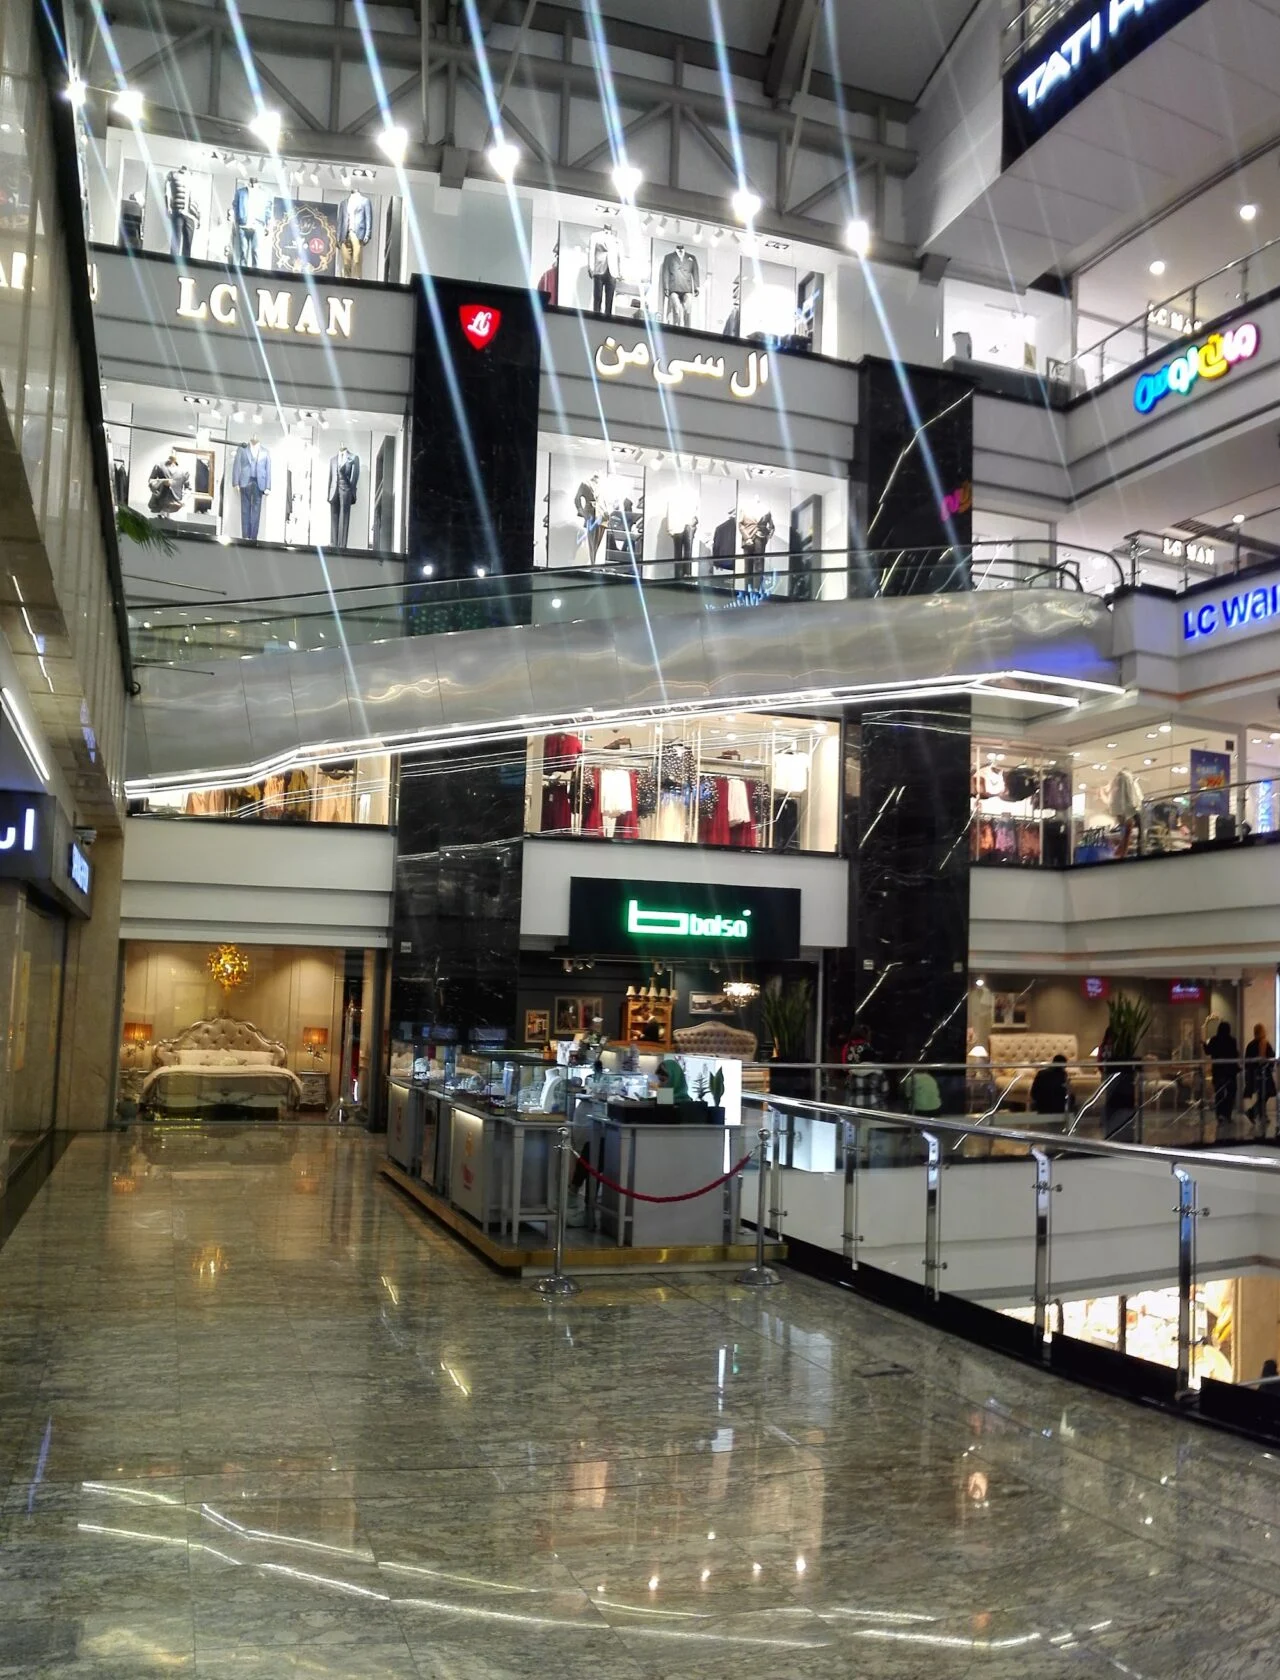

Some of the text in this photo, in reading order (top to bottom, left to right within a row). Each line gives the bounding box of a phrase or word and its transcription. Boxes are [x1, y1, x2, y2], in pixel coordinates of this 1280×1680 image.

[1018, 11, 1101, 108] TATI
[176, 276, 355, 339] LC MAN
[595, 336, 650, 376] من
[730, 350, 769, 398] ال
[1183, 603, 1217, 641] LC
